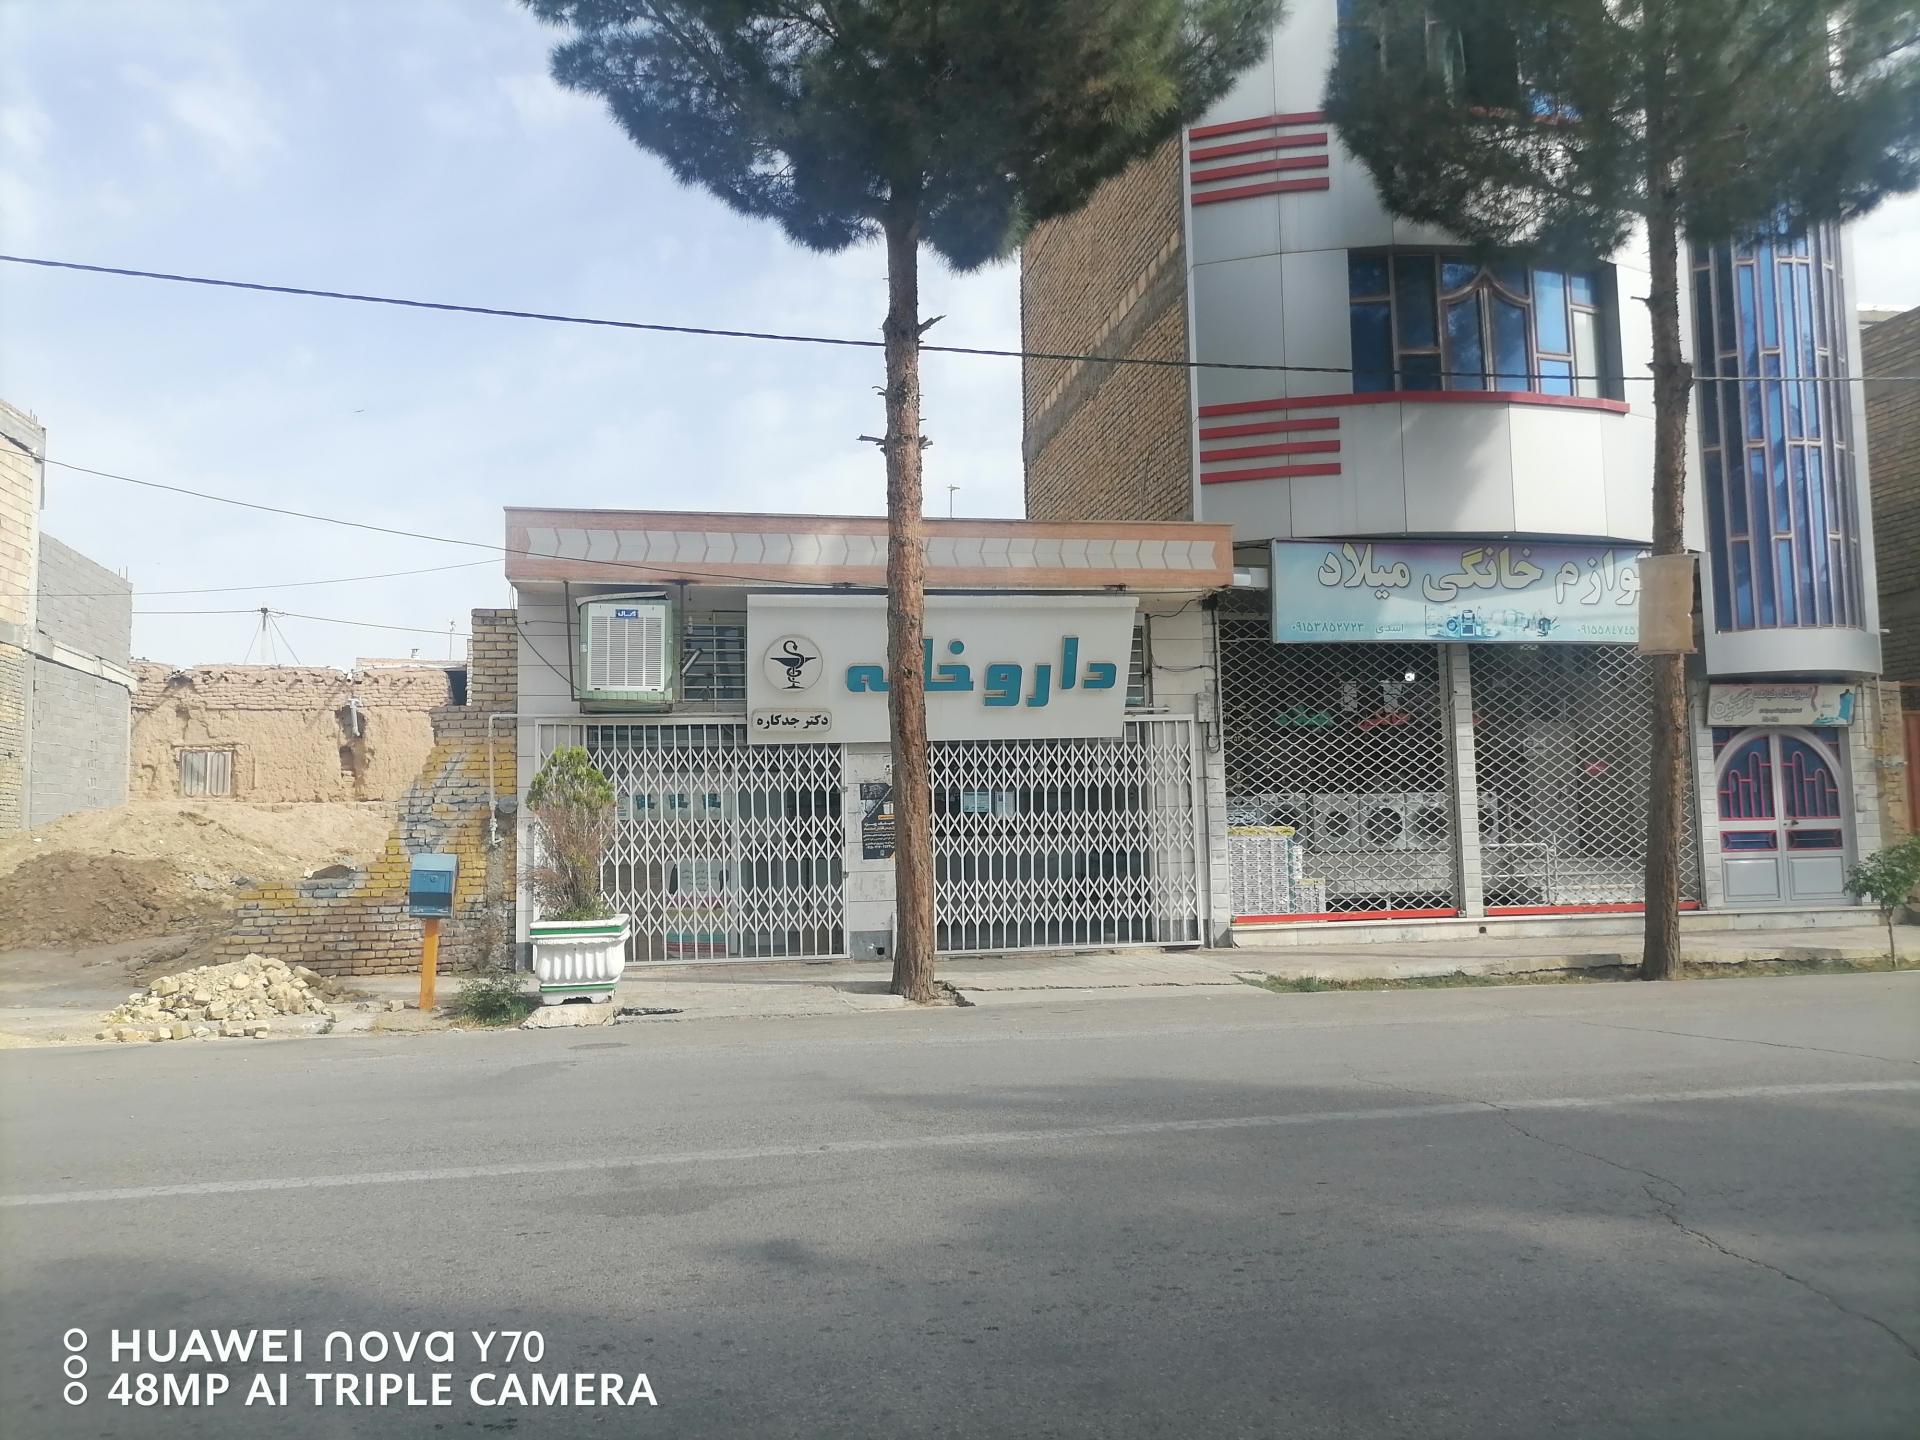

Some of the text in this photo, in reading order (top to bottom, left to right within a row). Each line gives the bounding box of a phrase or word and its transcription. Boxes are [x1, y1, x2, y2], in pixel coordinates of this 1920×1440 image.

[1318, 542, 1653, 606] وازم خانگی میلاد
[1375, 623, 1404, 634] اسدی
[846, 635, 1118, 708] داروخاه
[756, 714, 829, 729] دکتر جدکاره
